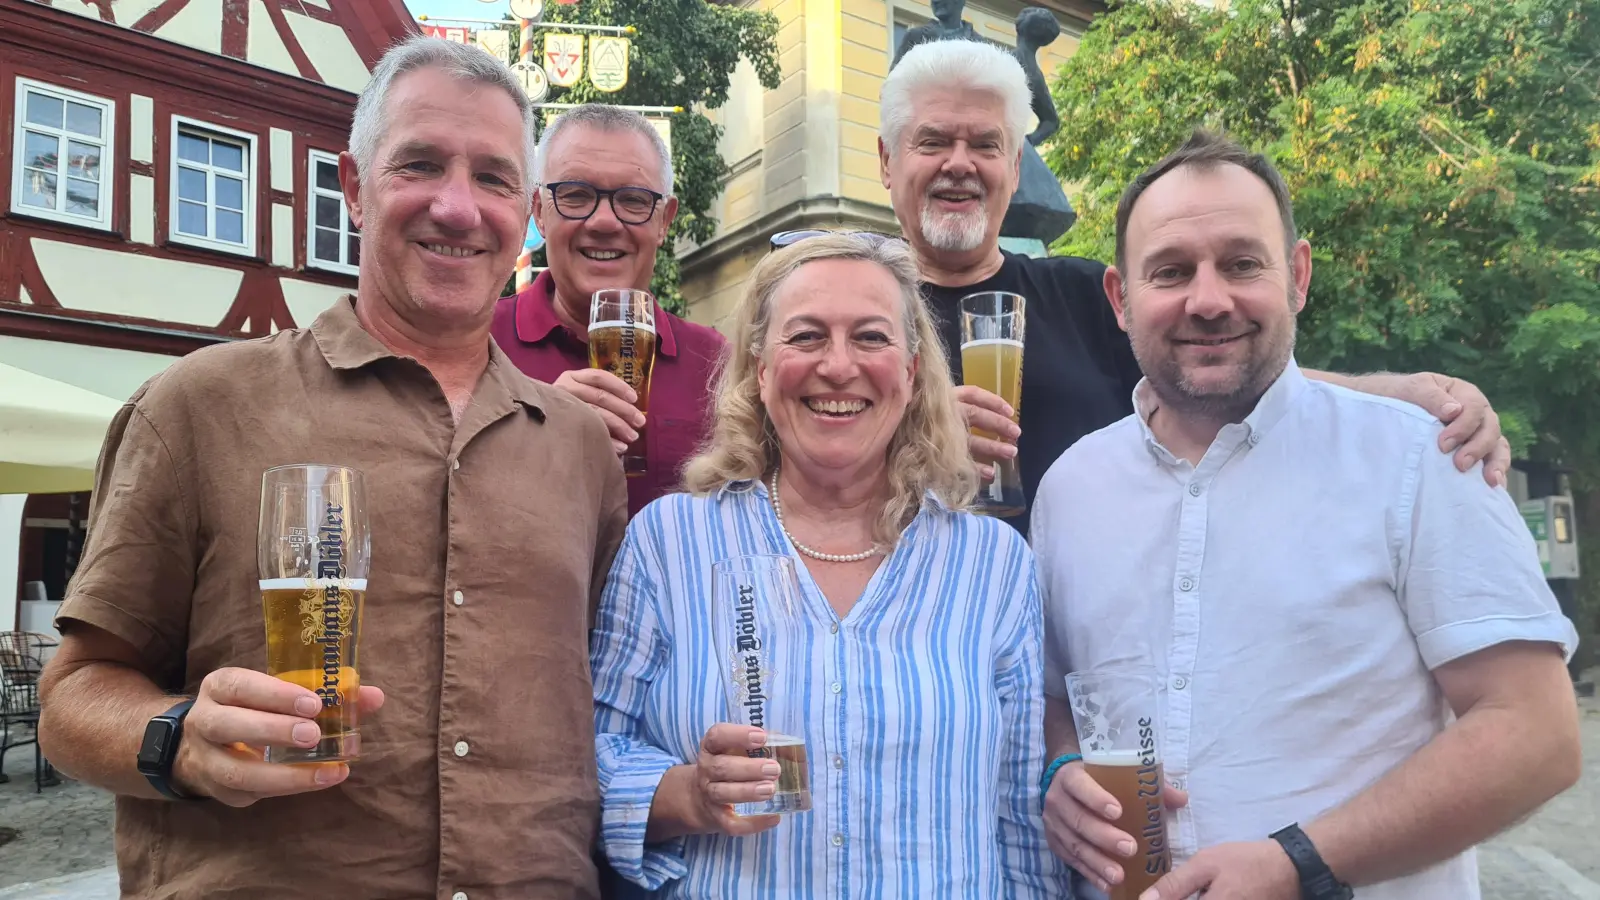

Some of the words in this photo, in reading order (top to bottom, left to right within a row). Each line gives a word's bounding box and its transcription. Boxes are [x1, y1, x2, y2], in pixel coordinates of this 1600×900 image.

[620, 308, 636, 358] Döbler
[317, 502, 347, 579] Döbler
[314, 585, 345, 707] Brauhaus
[735, 584, 762, 653] Döbler
[1137, 716, 1160, 798] Weisse
